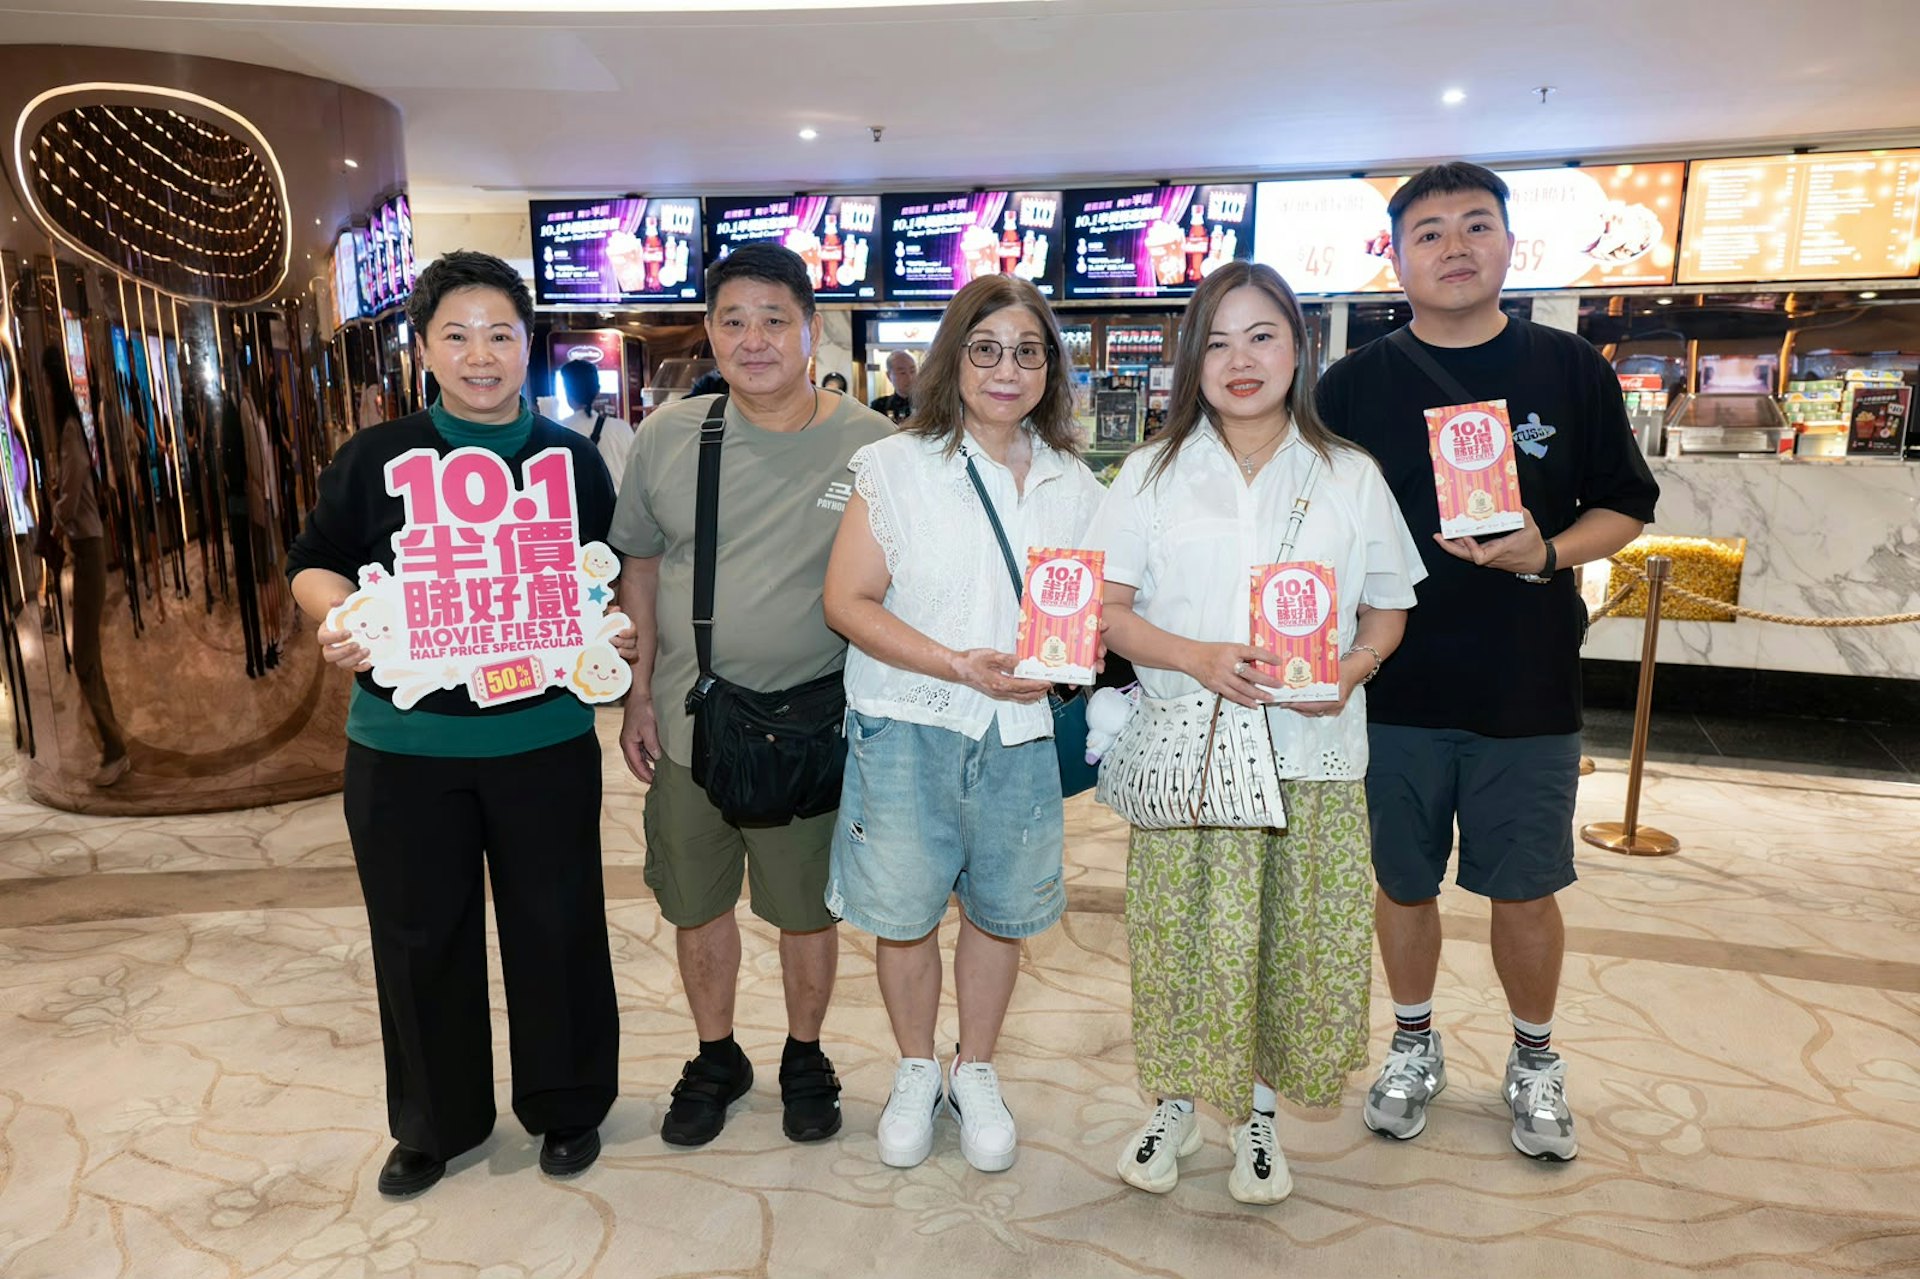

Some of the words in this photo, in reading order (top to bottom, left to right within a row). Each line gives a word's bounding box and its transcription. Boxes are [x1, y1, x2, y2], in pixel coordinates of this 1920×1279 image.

[1450, 417, 1491, 437] 10.1
[1453, 432, 1492, 447] 半價
[392, 453, 572, 524] 10.1
[399, 521, 577, 579] 半價
[1045, 566, 1083, 583] 10.1
[1043, 579, 1081, 591] 半價
[1274, 578, 1315, 596] 10.1
[403, 573, 582, 629] 睇好戲
[1276, 594, 1317, 608] 半價
[410, 625, 495, 649] MOVIE
[501, 619, 583, 645] FIESTA
[410, 648, 446, 660] HALF
[450, 644, 490, 657] PRICE
[493, 637, 584, 653] SPECTACULAR
[519, 676, 532, 688] off
